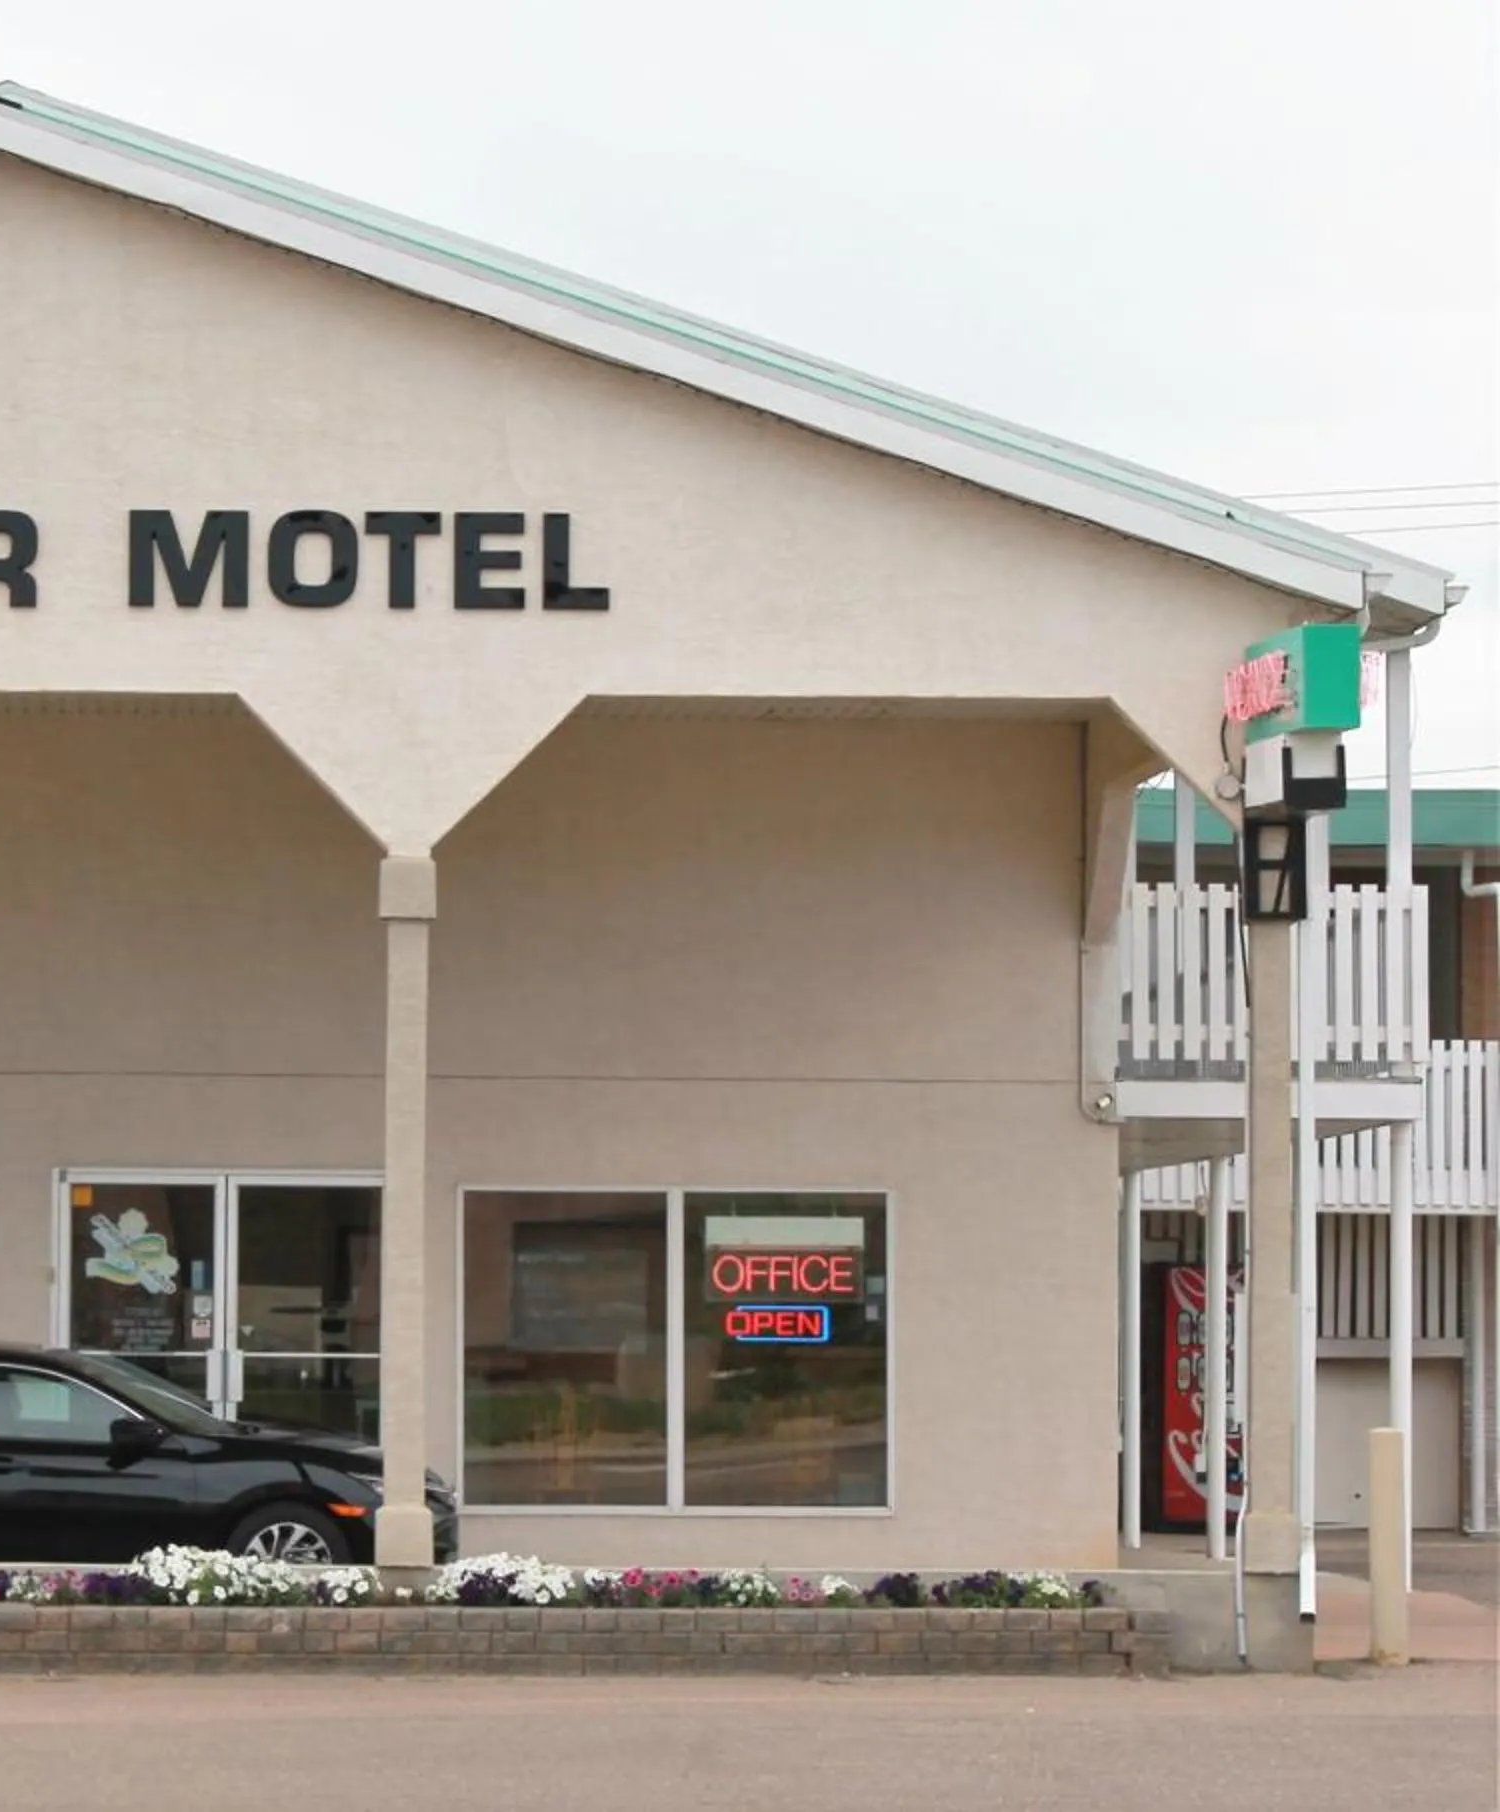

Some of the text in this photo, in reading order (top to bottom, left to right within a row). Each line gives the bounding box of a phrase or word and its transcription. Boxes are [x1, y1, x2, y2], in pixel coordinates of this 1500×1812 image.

[128, 509, 610, 611] MOTEL
[711, 1254, 854, 1293] OFFICE
[725, 1310, 821, 1337] OPEN
